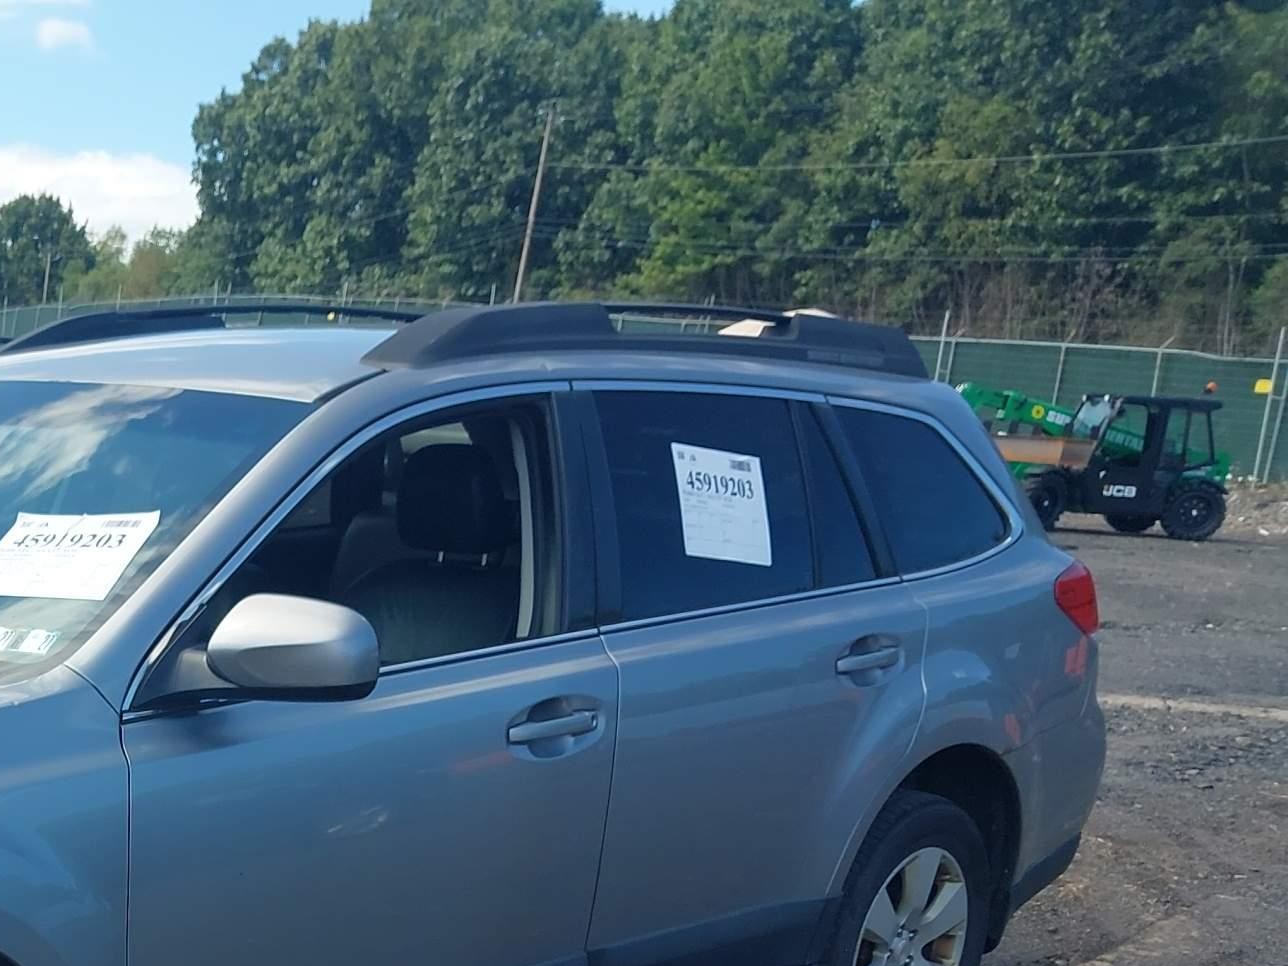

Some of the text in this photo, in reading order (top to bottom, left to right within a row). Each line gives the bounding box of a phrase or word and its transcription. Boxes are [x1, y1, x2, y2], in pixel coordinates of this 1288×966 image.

[686, 470, 754, 499] 45919203
[1103, 484, 1137, 498] JCB
[13, 532, 127, 549] 45919203
